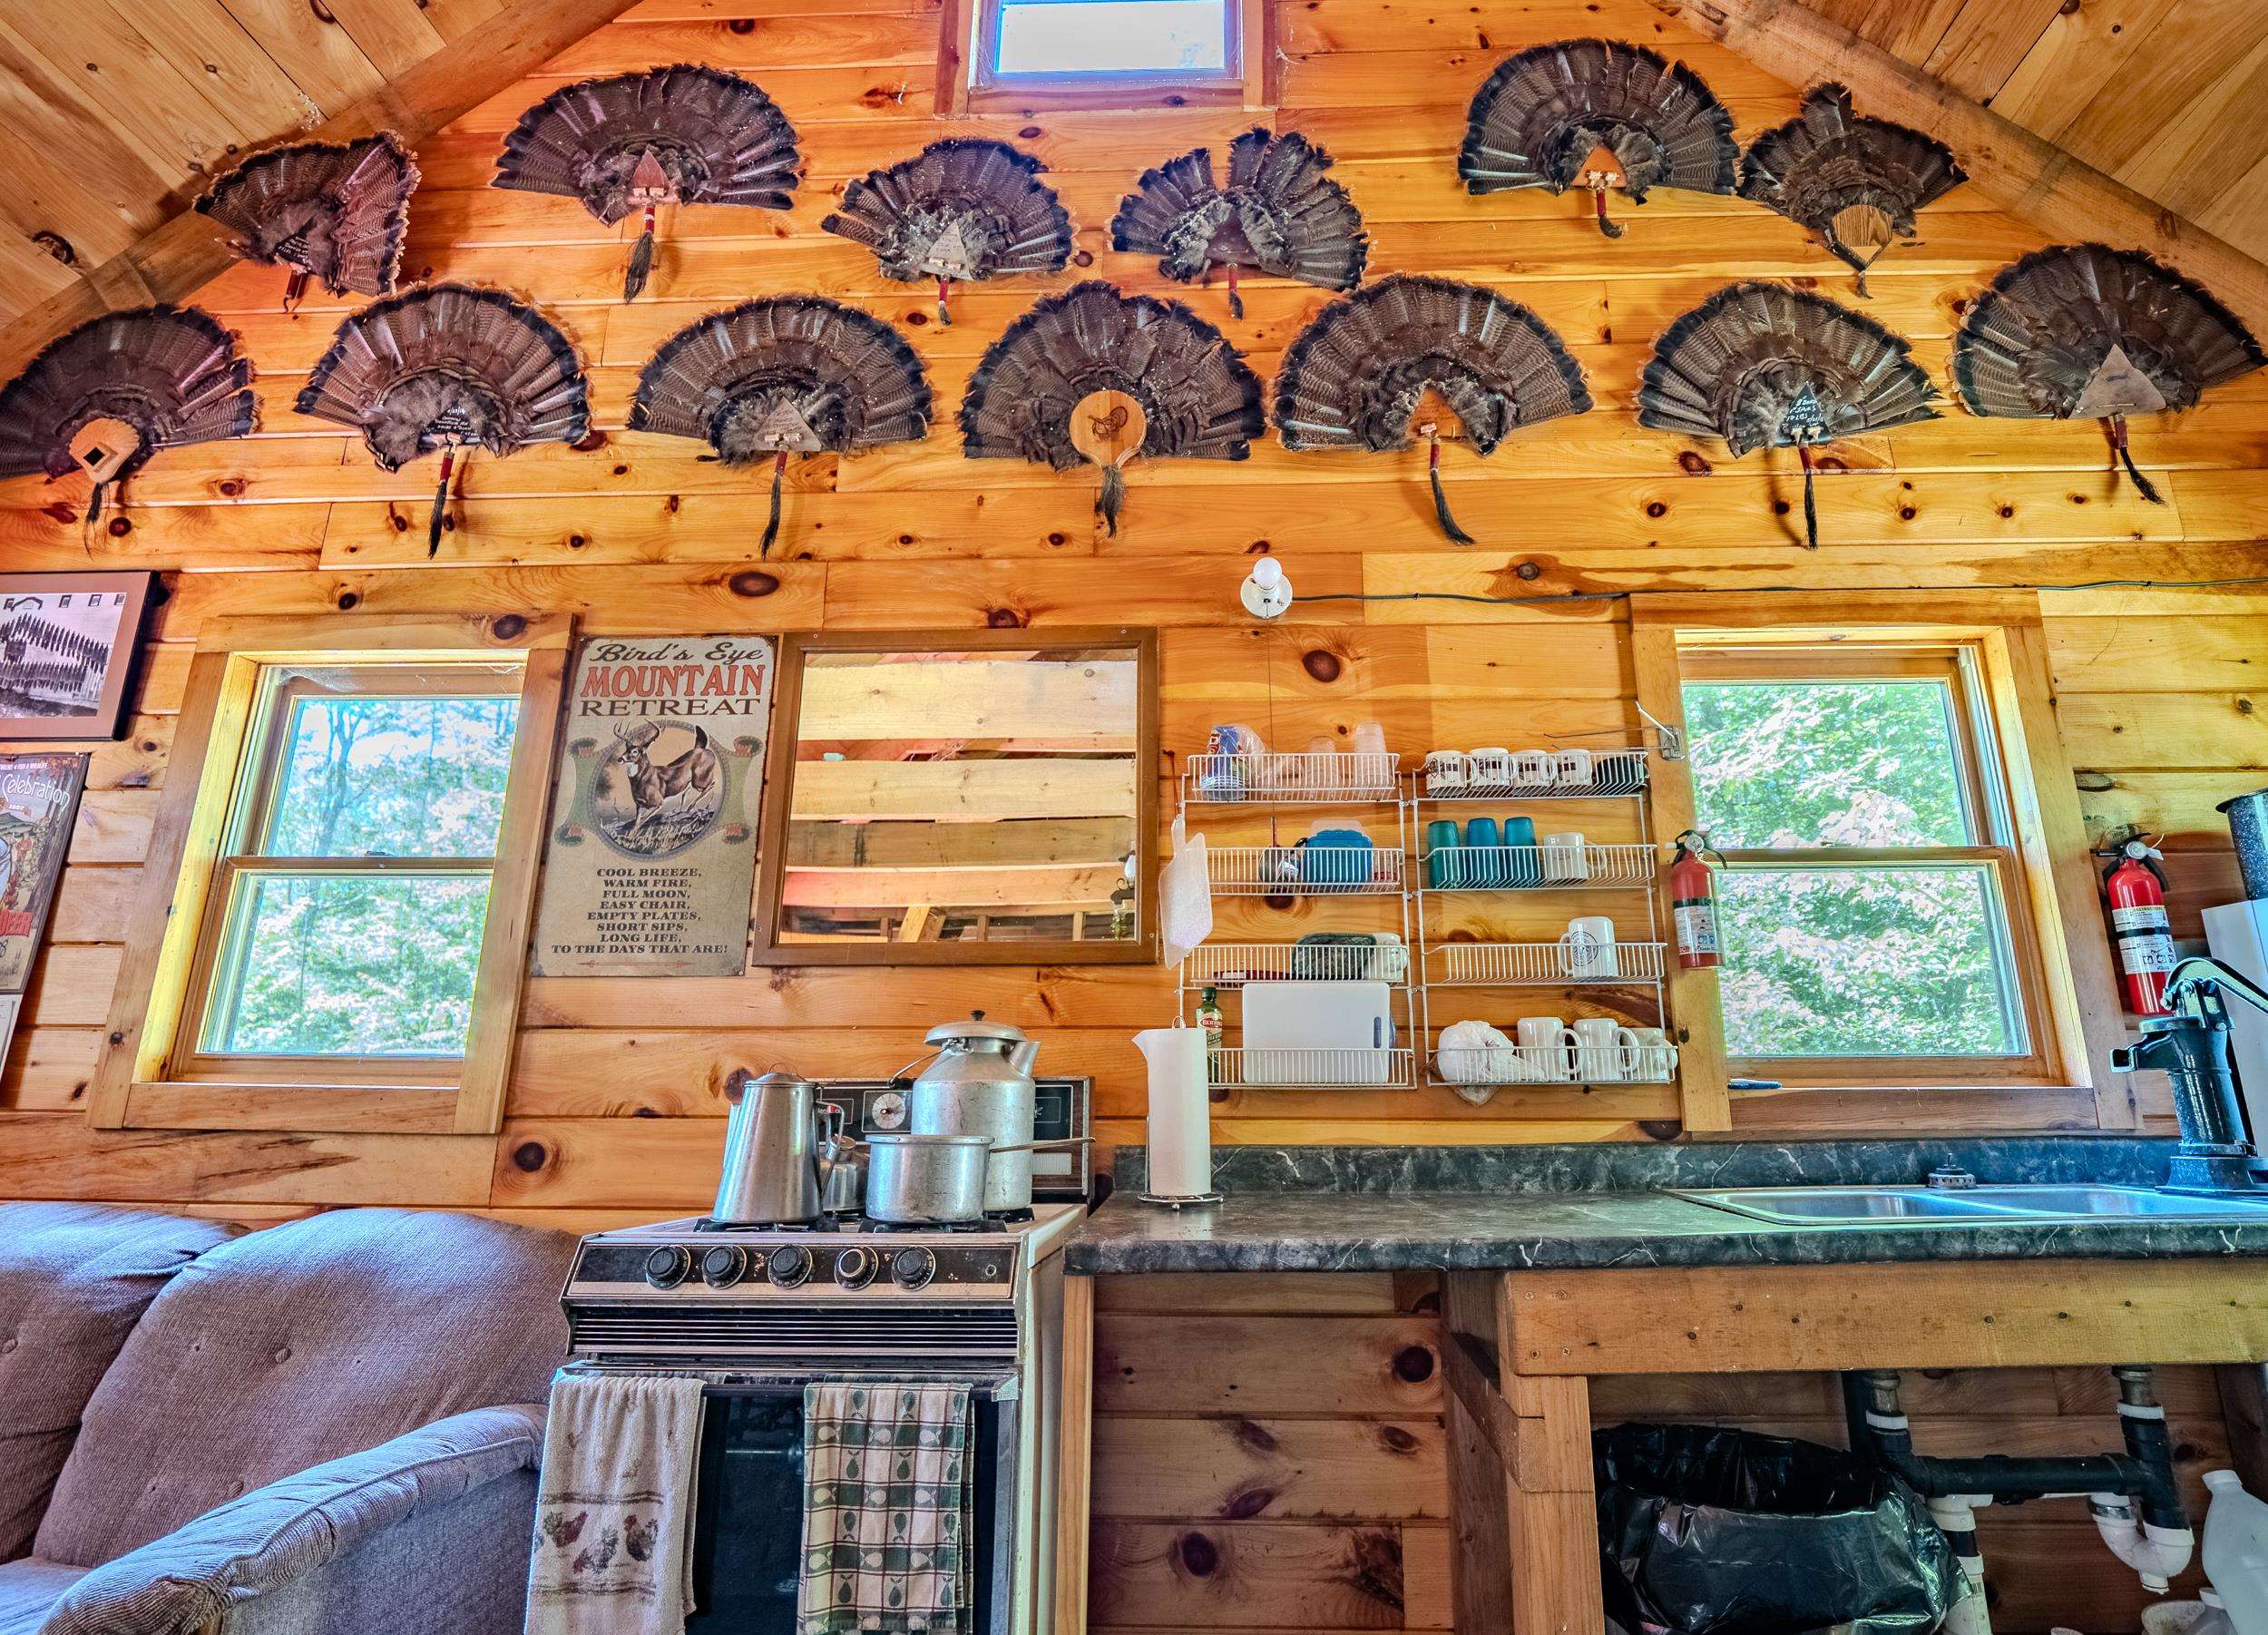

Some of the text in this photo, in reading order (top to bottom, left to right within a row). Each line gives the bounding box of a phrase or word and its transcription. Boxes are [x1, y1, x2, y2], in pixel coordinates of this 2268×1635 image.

[589, 641, 764, 665] Bird's Eye
[580, 664, 767, 698] MOUNTAIN
[578, 698, 761, 717] RETREAT
[2, 773, 71, 812] Celebration
[596, 868, 637, 877] COOL
[603, 878, 692, 888] WARM FIRE,
[602, 890, 691, 899] FULL MOON,
[600, 901, 690, 910] EASY CHAIR,
[587, 912, 701, 921] EMPTY PLATES,
[596, 923, 689, 932] SHORT SIPS,
[600, 934, 640, 943] LONG
[552, 945, 728, 954] TO THE DAYS THAT ARE!
